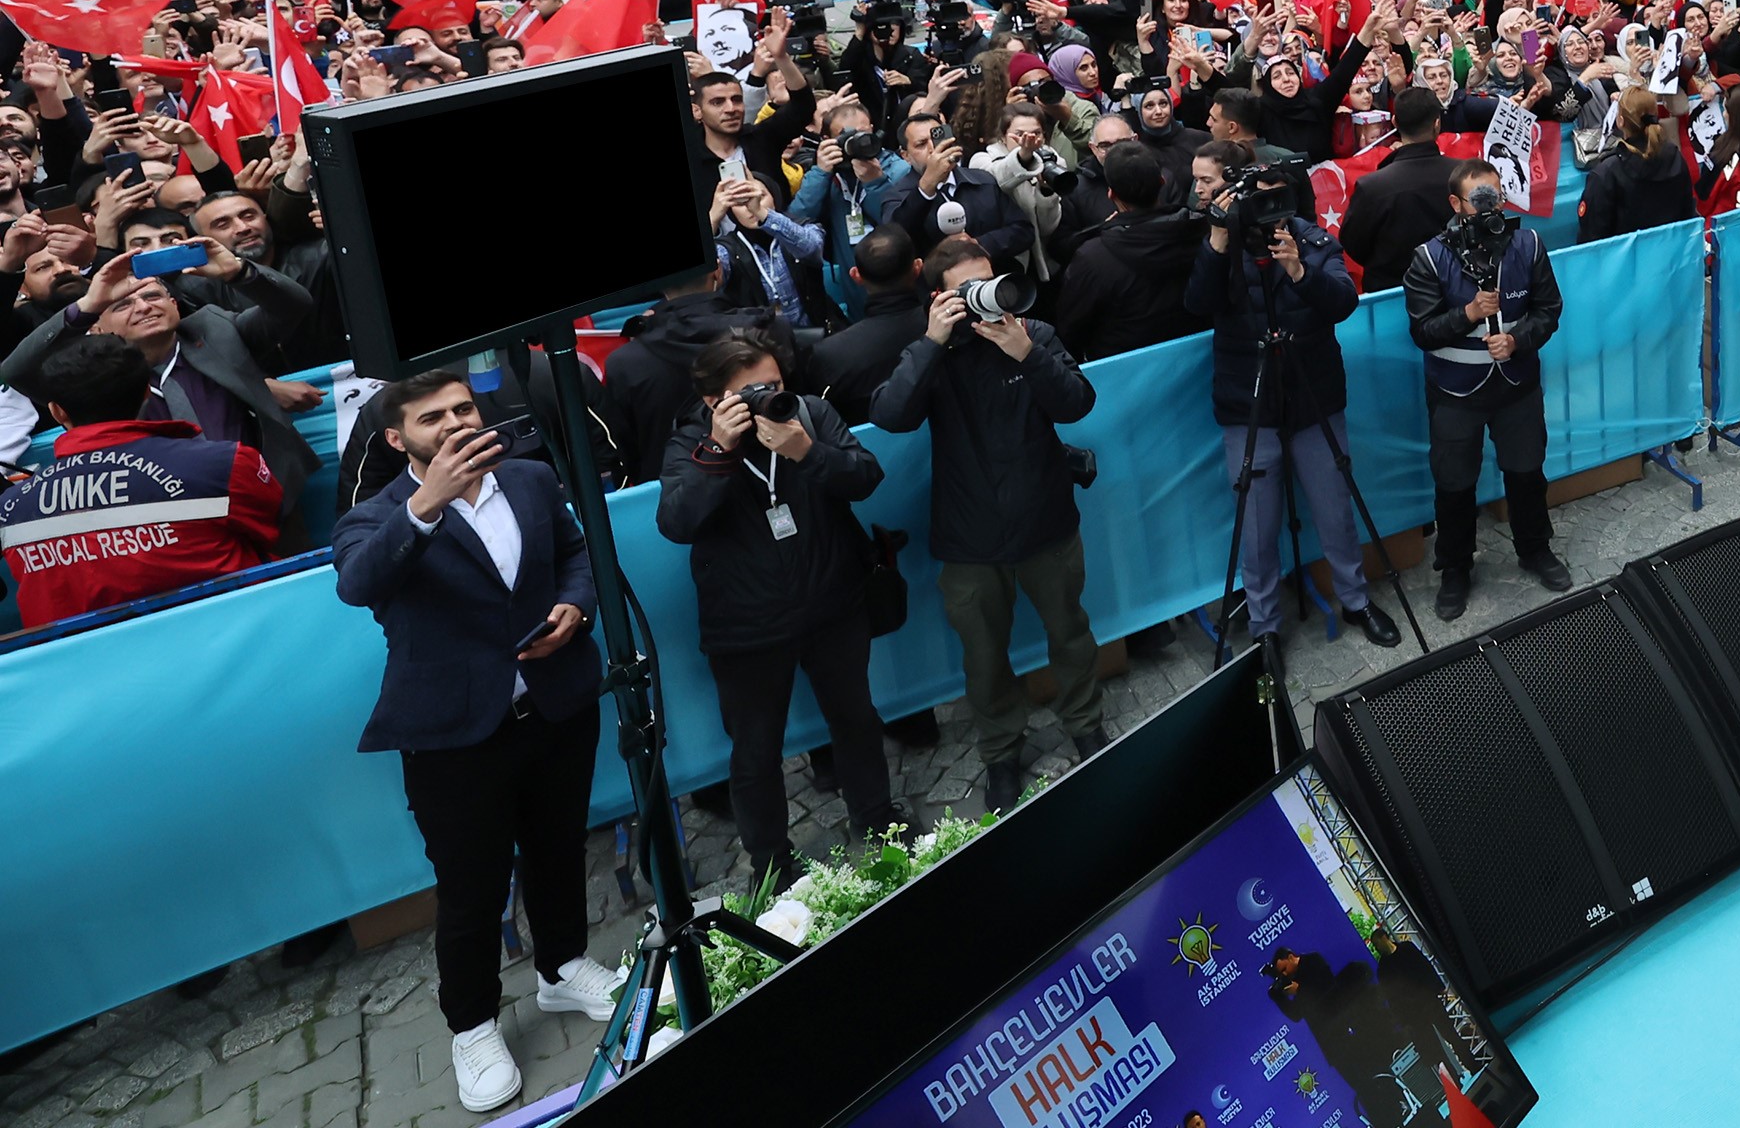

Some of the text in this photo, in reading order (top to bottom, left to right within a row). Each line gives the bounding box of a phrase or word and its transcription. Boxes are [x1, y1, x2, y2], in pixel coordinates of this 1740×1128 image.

[1501, 104, 1520, 143] REİS
[39, 469, 130, 515] UMKE
[90, 451, 185, 498] BAKANLIĞI
[97, 523, 179, 559] RESCUE
[1586, 904, 1606, 922] d&b
[1197, 982, 1212, 999] AK
[923, 933, 1137, 1122] BAHÇELİEVLER
[1010, 1015, 1116, 1126] HALK
[1040, 1037, 1162, 1128] UŞMASI
